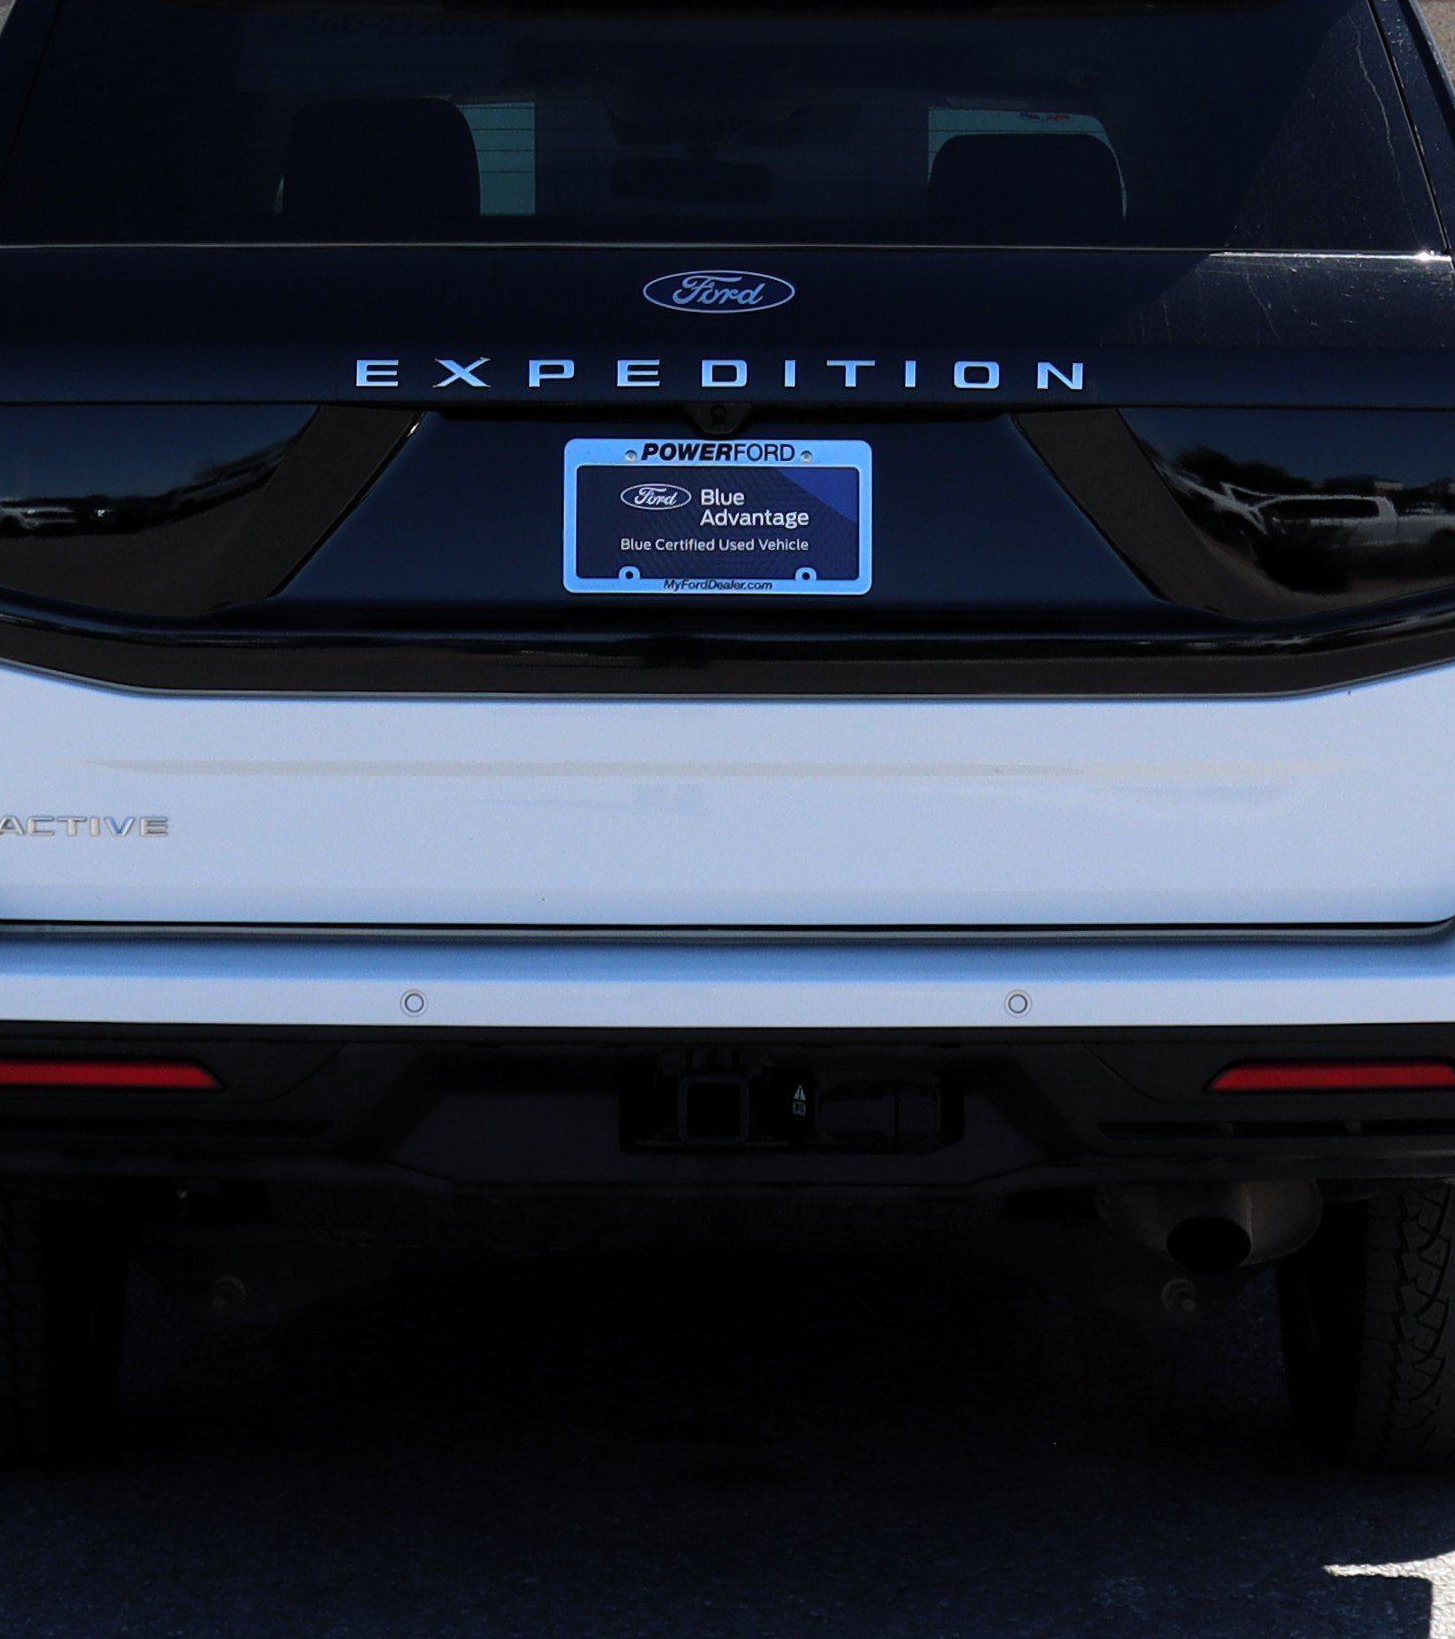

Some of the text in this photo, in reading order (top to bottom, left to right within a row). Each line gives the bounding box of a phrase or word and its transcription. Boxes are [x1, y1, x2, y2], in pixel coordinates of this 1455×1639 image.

[672, 274, 764, 307] Ford
[355, 357, 1084, 390] EXPEDITION
[641, 443, 795, 461] POWERFORD
[634, 487, 679, 506] Ford
[700, 488, 745, 506] Blue
[699, 509, 810, 529] Advantage
[620, 538, 809, 551] Blue Certified Used Vehicle
[663, 579, 773, 592] MyFordDealer.com
